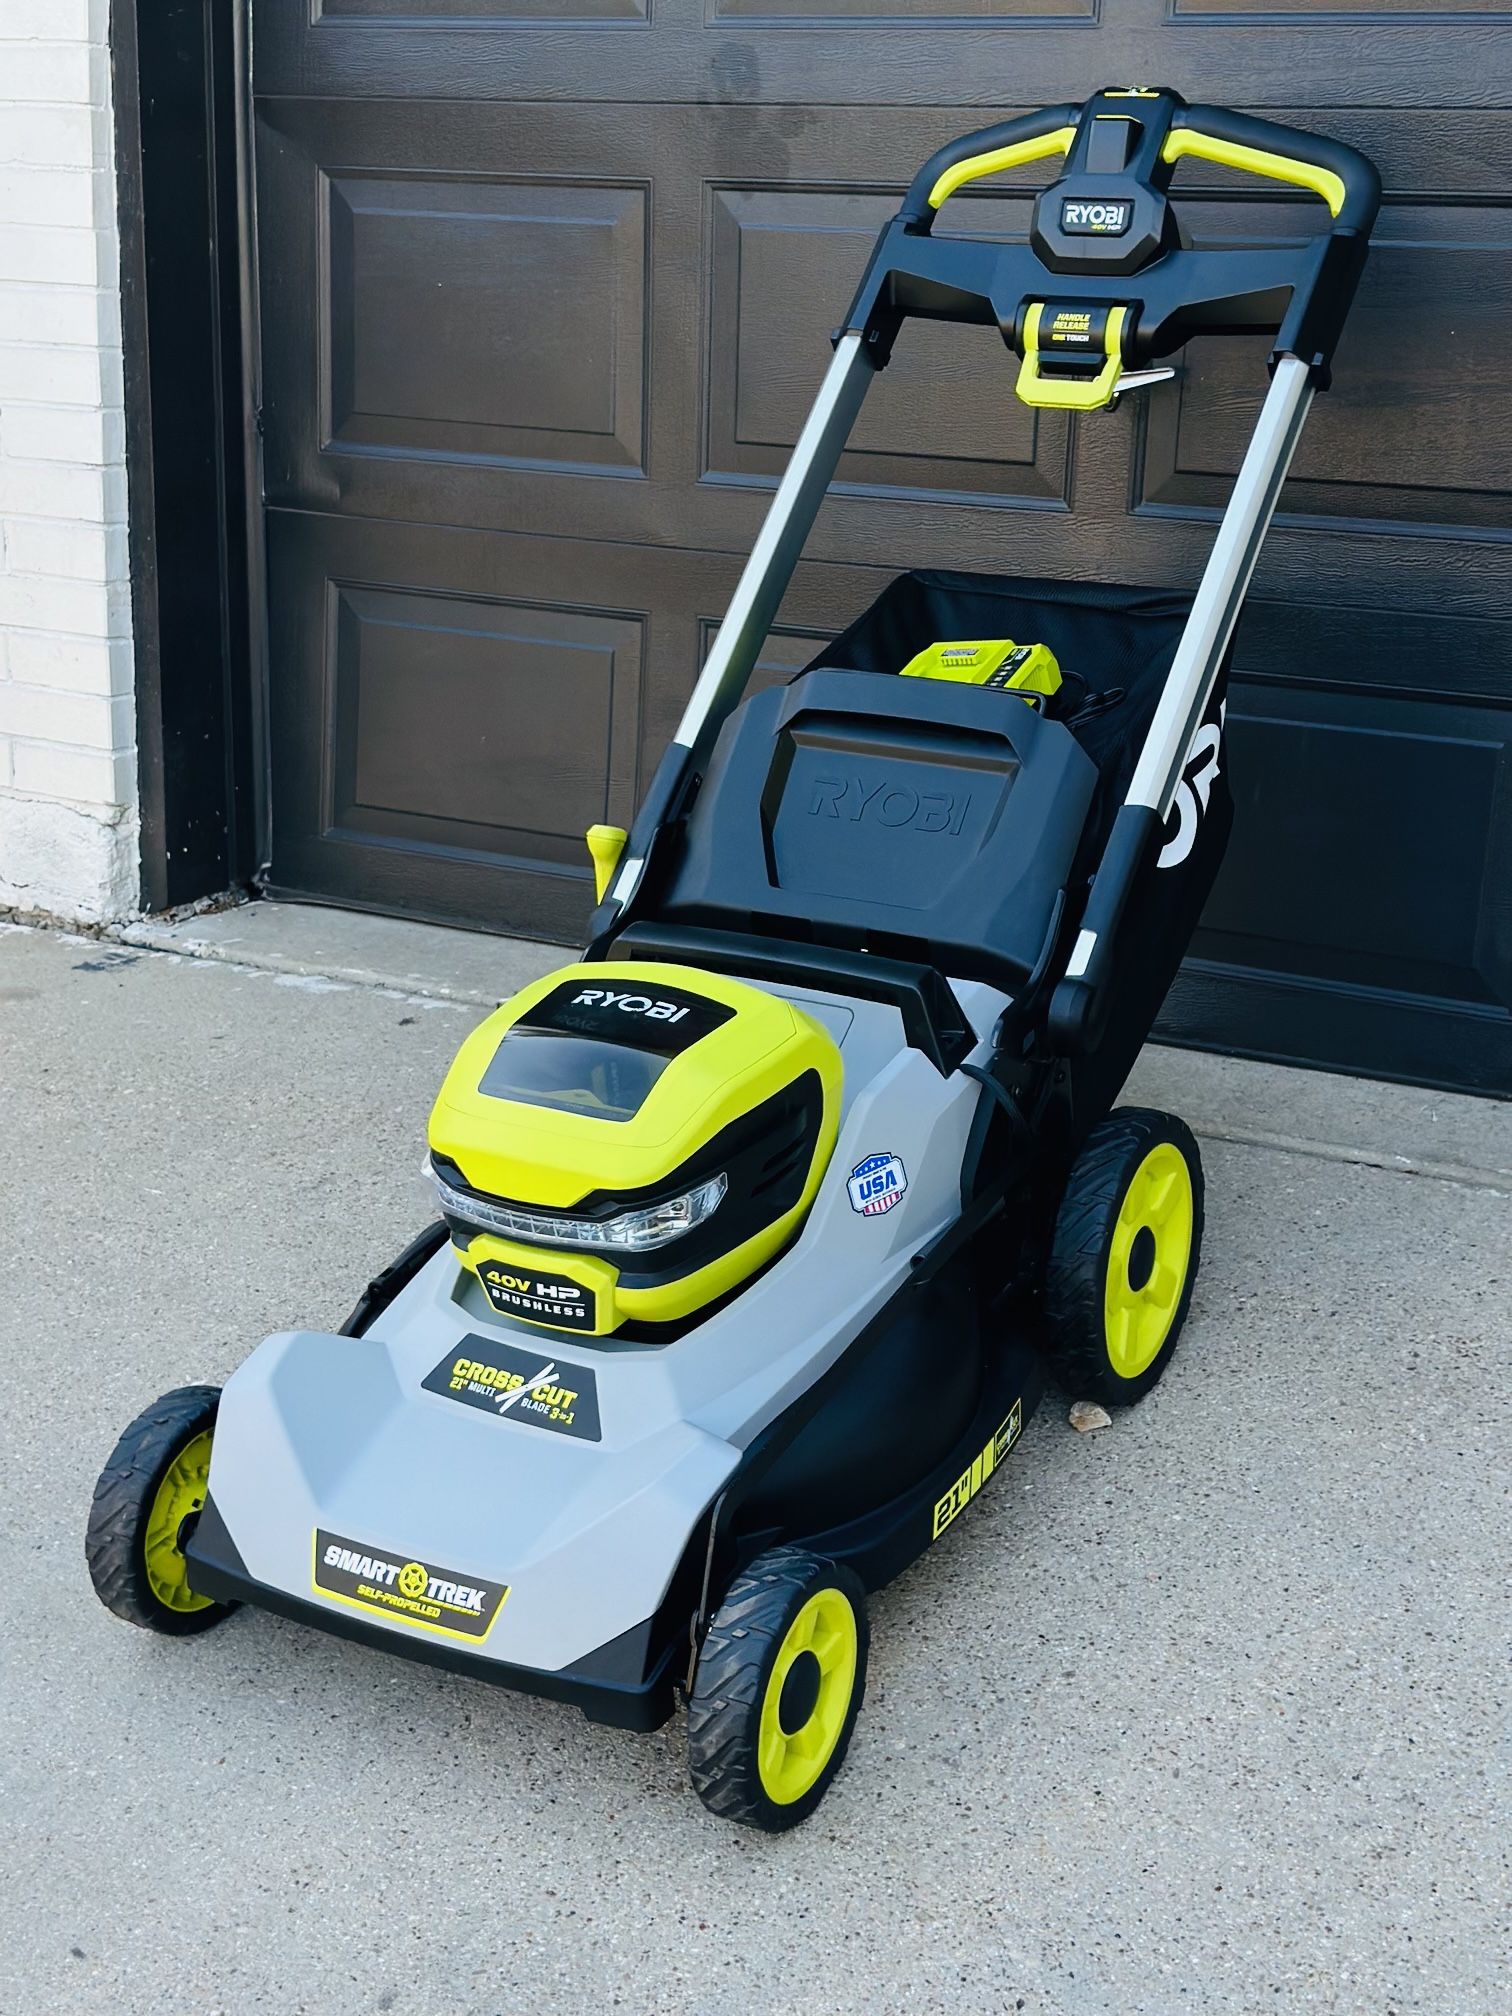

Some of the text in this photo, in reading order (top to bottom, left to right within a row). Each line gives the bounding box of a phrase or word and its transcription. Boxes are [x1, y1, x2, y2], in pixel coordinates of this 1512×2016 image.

[1066, 205, 1124, 224] RYOBI
[1053, 321, 1090, 330] RELEASE
[1057, 313, 1091, 321] HANDLE
[808, 777, 972, 836] RYOBI
[571, 989, 691, 1023] RYOBI
[859, 1169, 897, 1200] USA
[486, 1270, 581, 1299] 40V HP
[492, 1288, 585, 1317] BRUSHLESS
[449, 1376, 468, 1391] 21"
[468, 1381, 497, 1397] MULTI
[520, 1397, 551, 1414] BLADE
[452, 1358, 579, 1408] CROSS CUT
[323, 1544, 487, 1611] SMART TREK
[356, 1584, 442, 1618] SELF-PROPELLED
